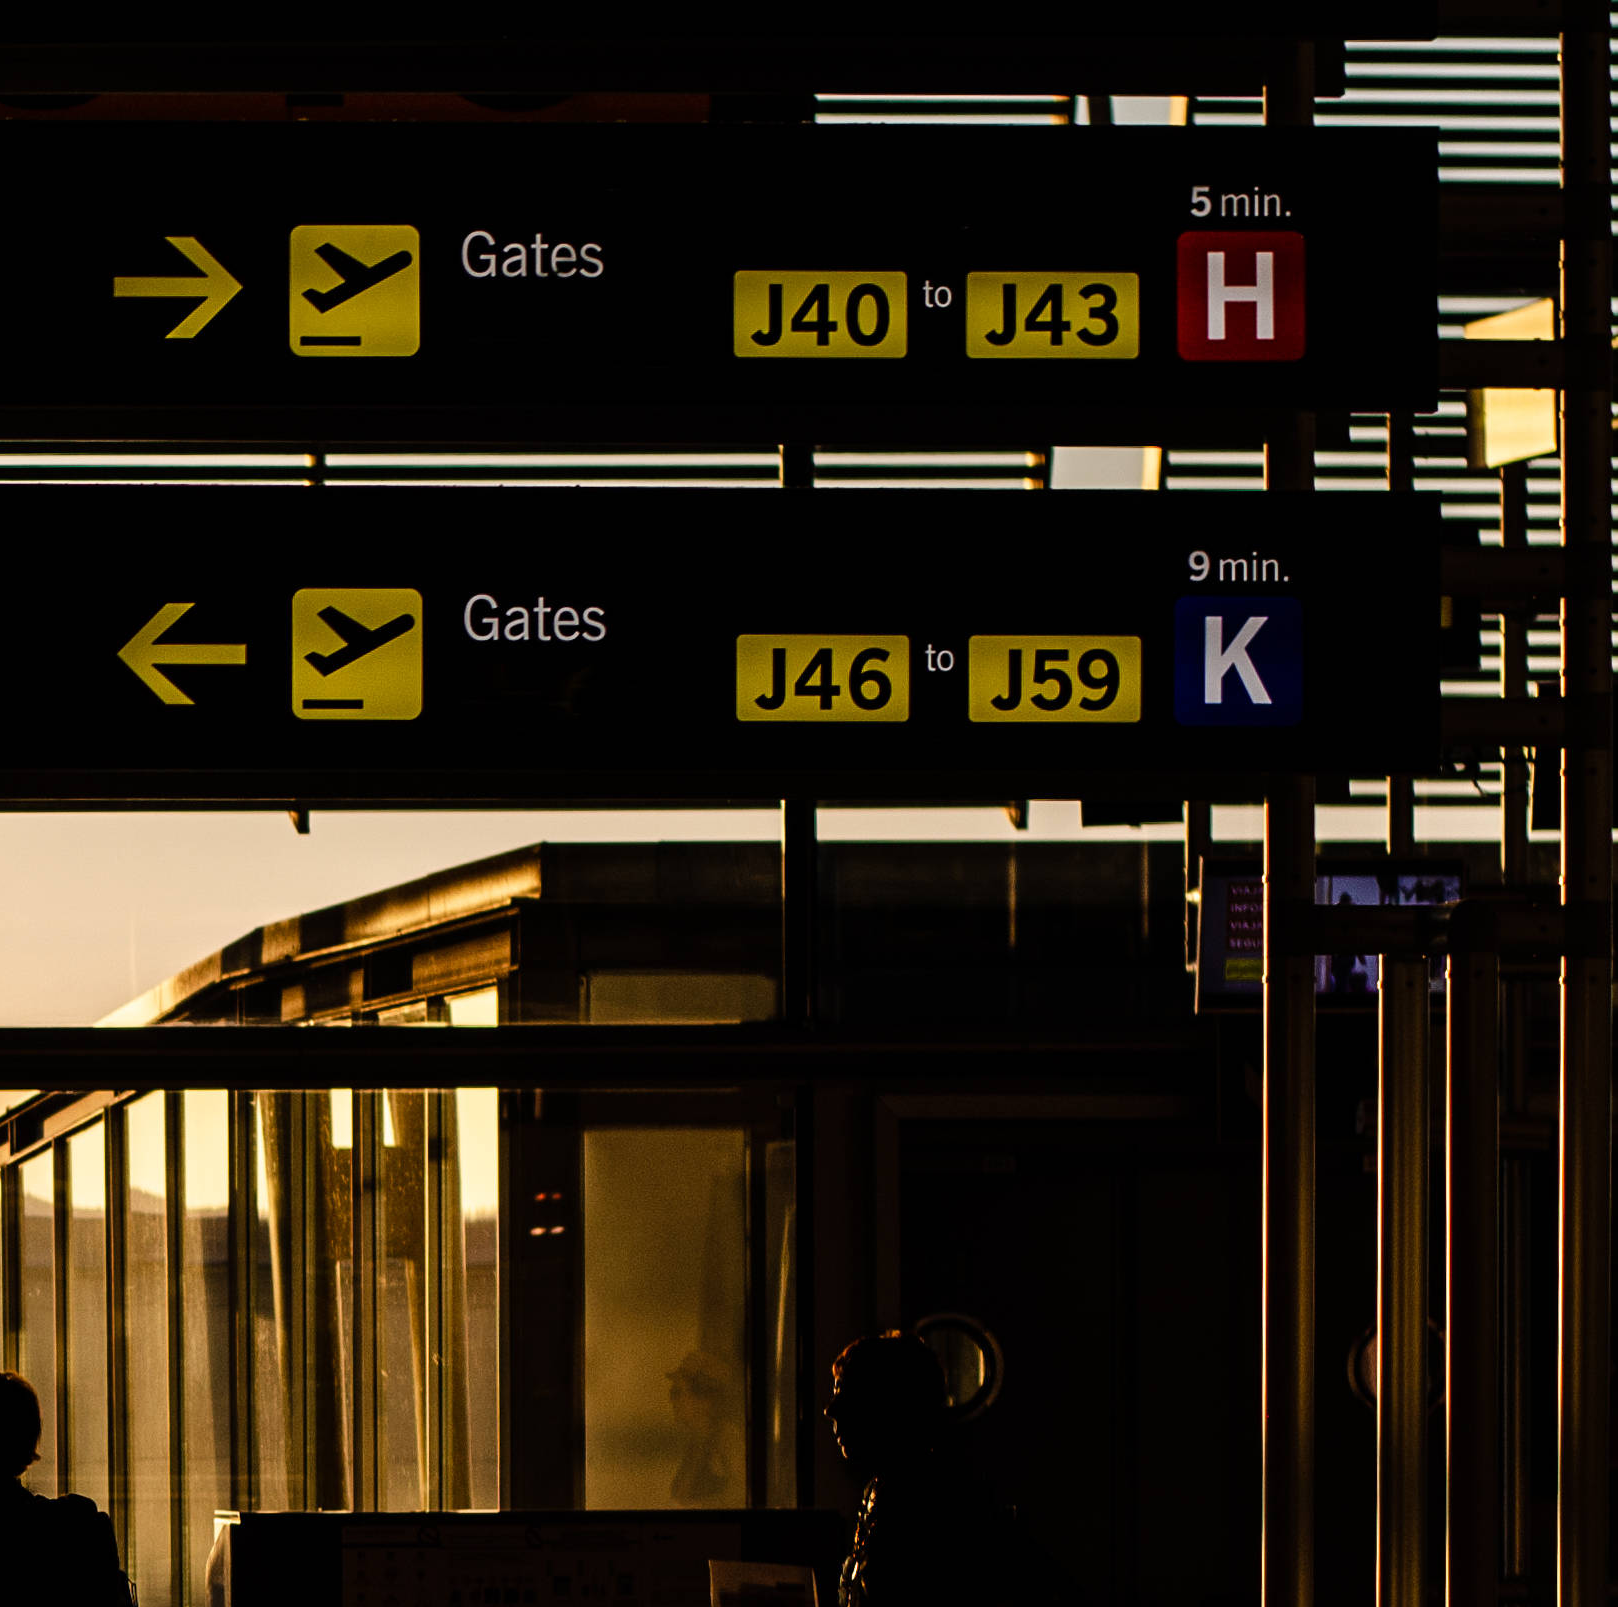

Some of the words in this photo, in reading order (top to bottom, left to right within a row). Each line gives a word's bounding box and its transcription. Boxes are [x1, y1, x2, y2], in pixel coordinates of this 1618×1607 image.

[1190, 186, 1212, 218] 5
[1221, 187, 1293, 217] min.
[461, 230, 605, 278] Gates
[750, 282, 890, 347] J40
[922, 279, 953, 308] to
[984, 282, 1121, 347] J43
[1207, 251, 1275, 341] H
[1188, 550, 1210, 582] 9
[1219, 551, 1291, 582] min.
[464, 594, 607, 642] Gates
[754, 647, 892, 711] J46
[925, 643, 955, 672] to
[990, 648, 1121, 712] J59
[1204, 615, 1273, 705] K
